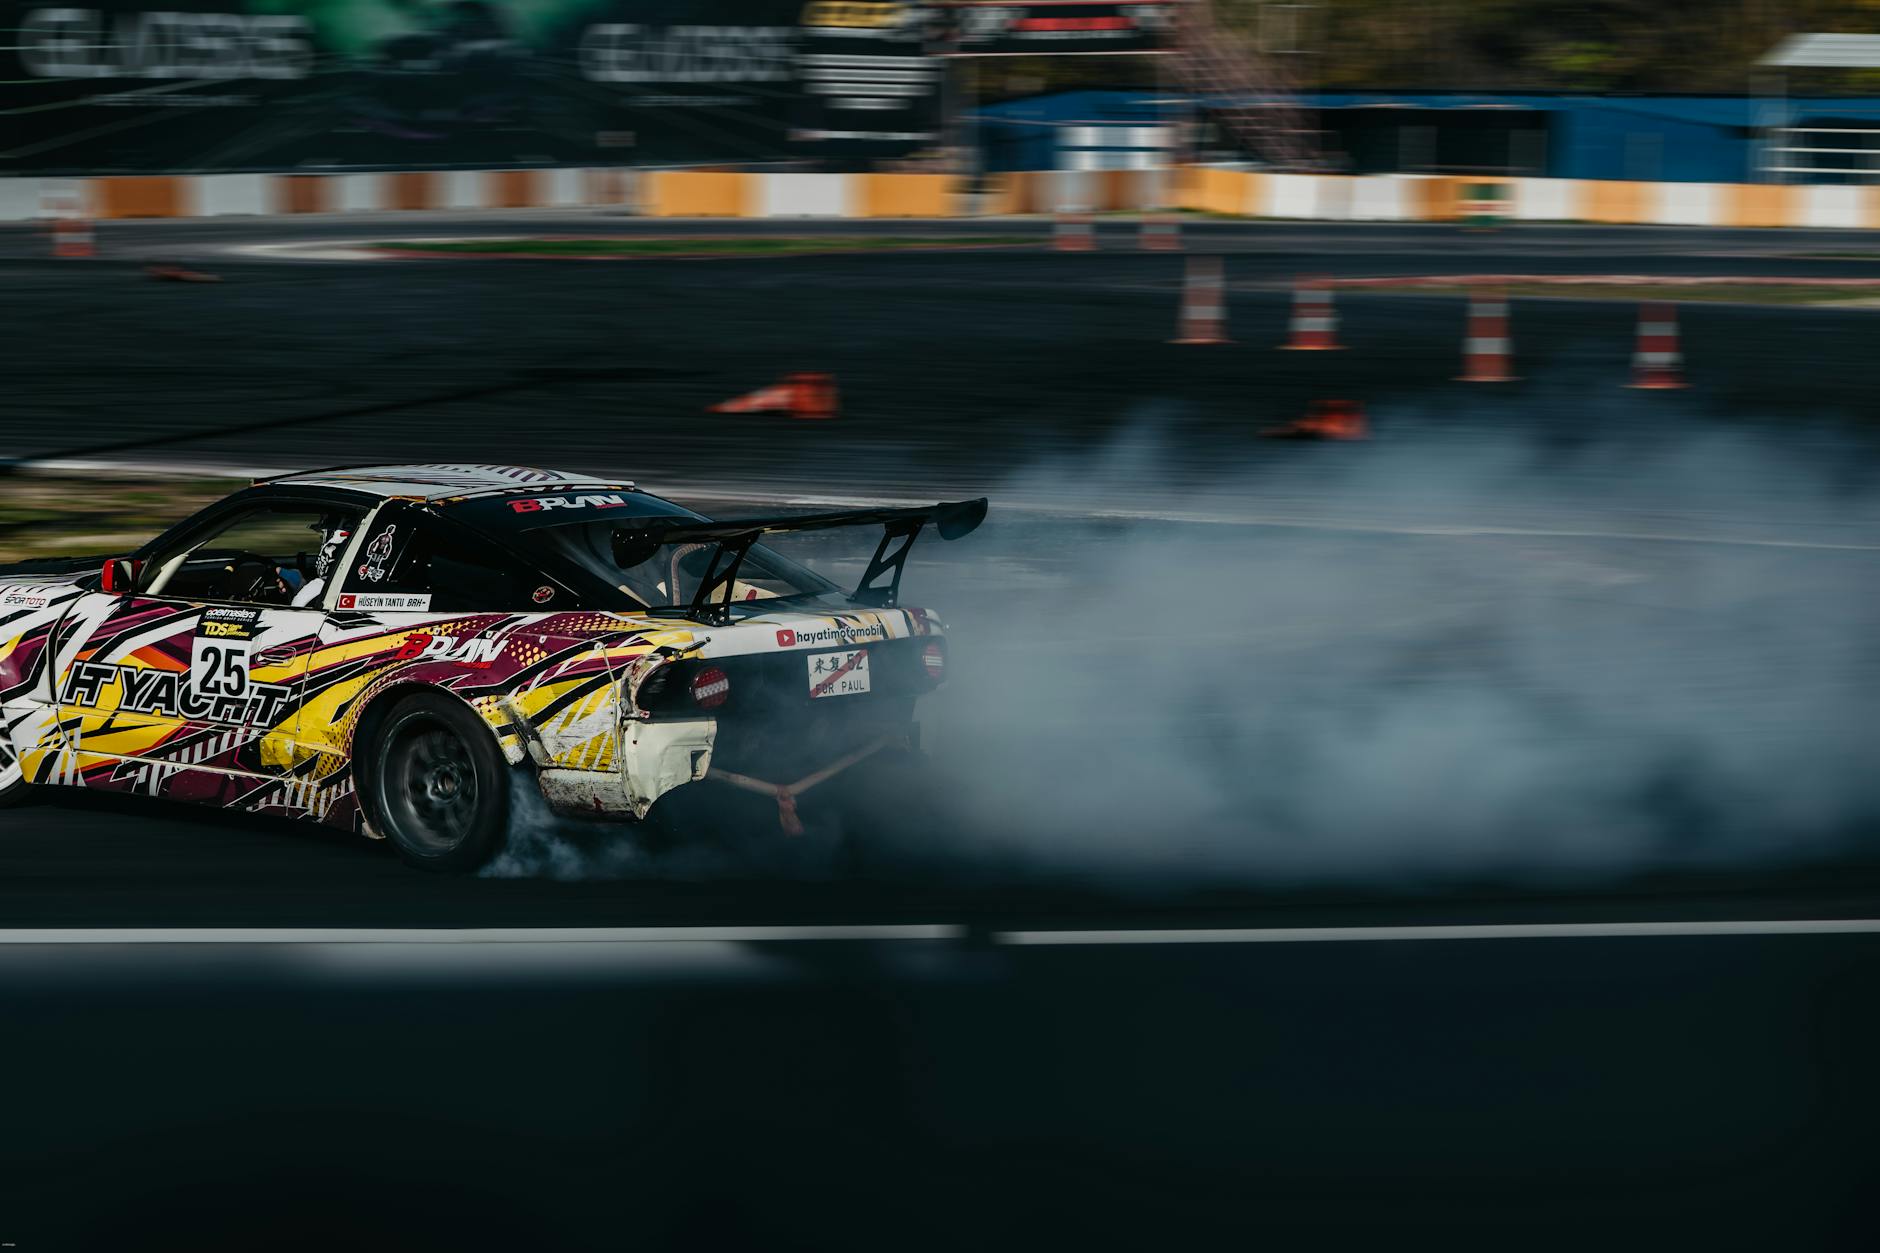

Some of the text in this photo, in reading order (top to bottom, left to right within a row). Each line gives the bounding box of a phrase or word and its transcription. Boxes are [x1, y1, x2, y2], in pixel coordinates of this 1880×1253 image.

[506, 495, 626, 513] BPLAN
[358, 595, 383, 607] HÜSEYİN
[385, 597, 405, 607] TANTU
[201, 621, 228, 636] TDS
[395, 633, 510, 664] BPLAN
[200, 646, 246, 697] 25
[118, 666, 292, 728] YACHT
[815, 679, 865, 697] FOR PAUL
